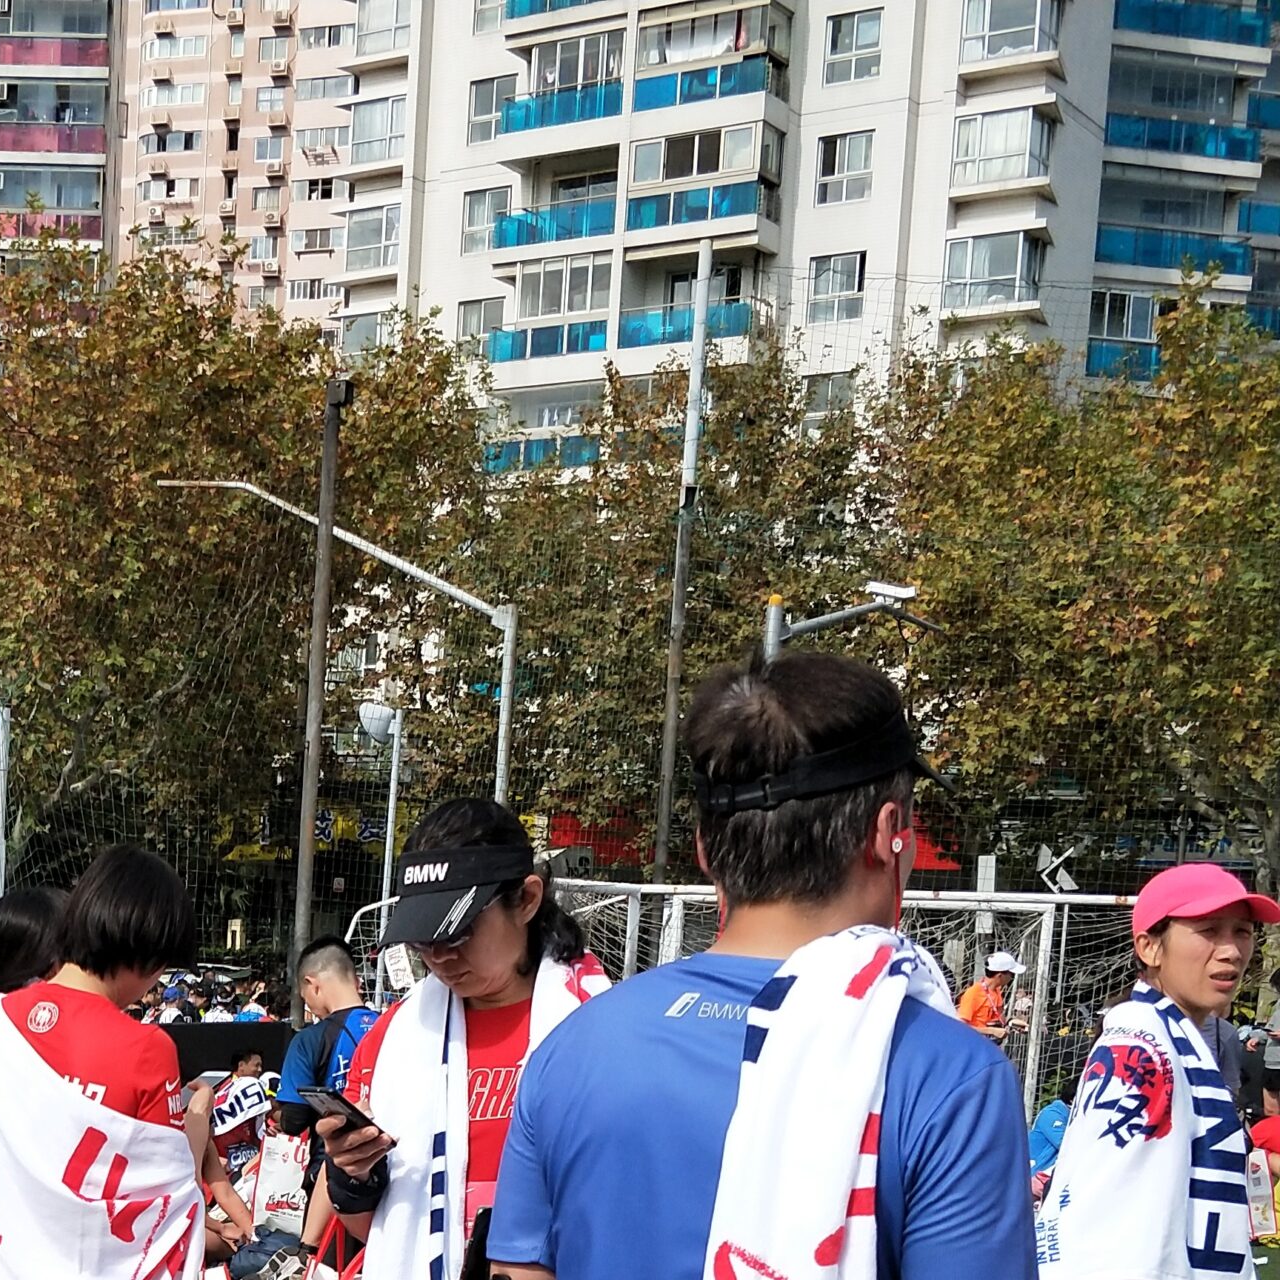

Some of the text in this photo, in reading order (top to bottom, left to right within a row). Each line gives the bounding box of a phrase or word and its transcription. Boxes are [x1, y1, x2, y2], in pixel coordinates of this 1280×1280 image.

[404, 862, 449, 885] BMW
[698, 1001, 749, 1020] BMW
[168, 1094, 184, 1116] NR
